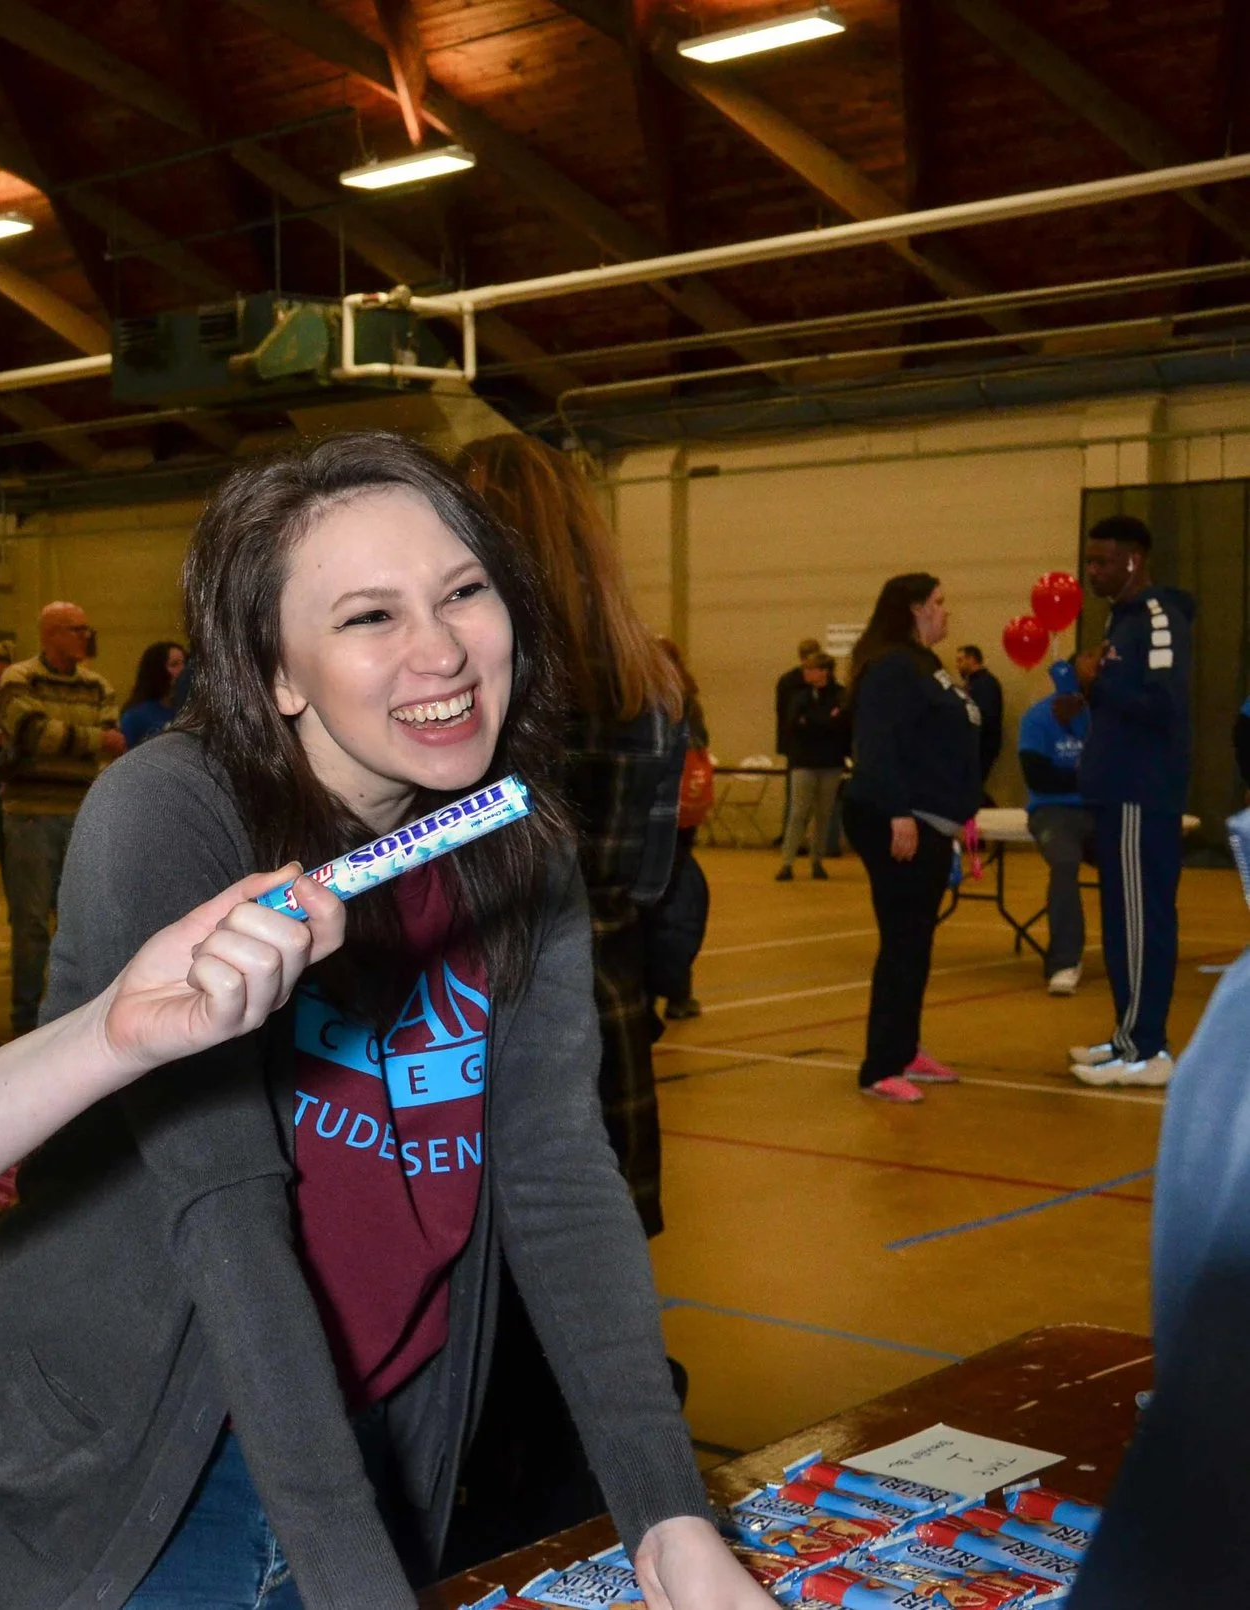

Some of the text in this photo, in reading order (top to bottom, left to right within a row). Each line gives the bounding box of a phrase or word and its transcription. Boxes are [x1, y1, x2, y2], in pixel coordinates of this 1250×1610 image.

[348, 784, 507, 870] mentos
[1002, 1543, 1071, 1574] NUTRI
[553, 1575, 621, 1598] NUTRI
